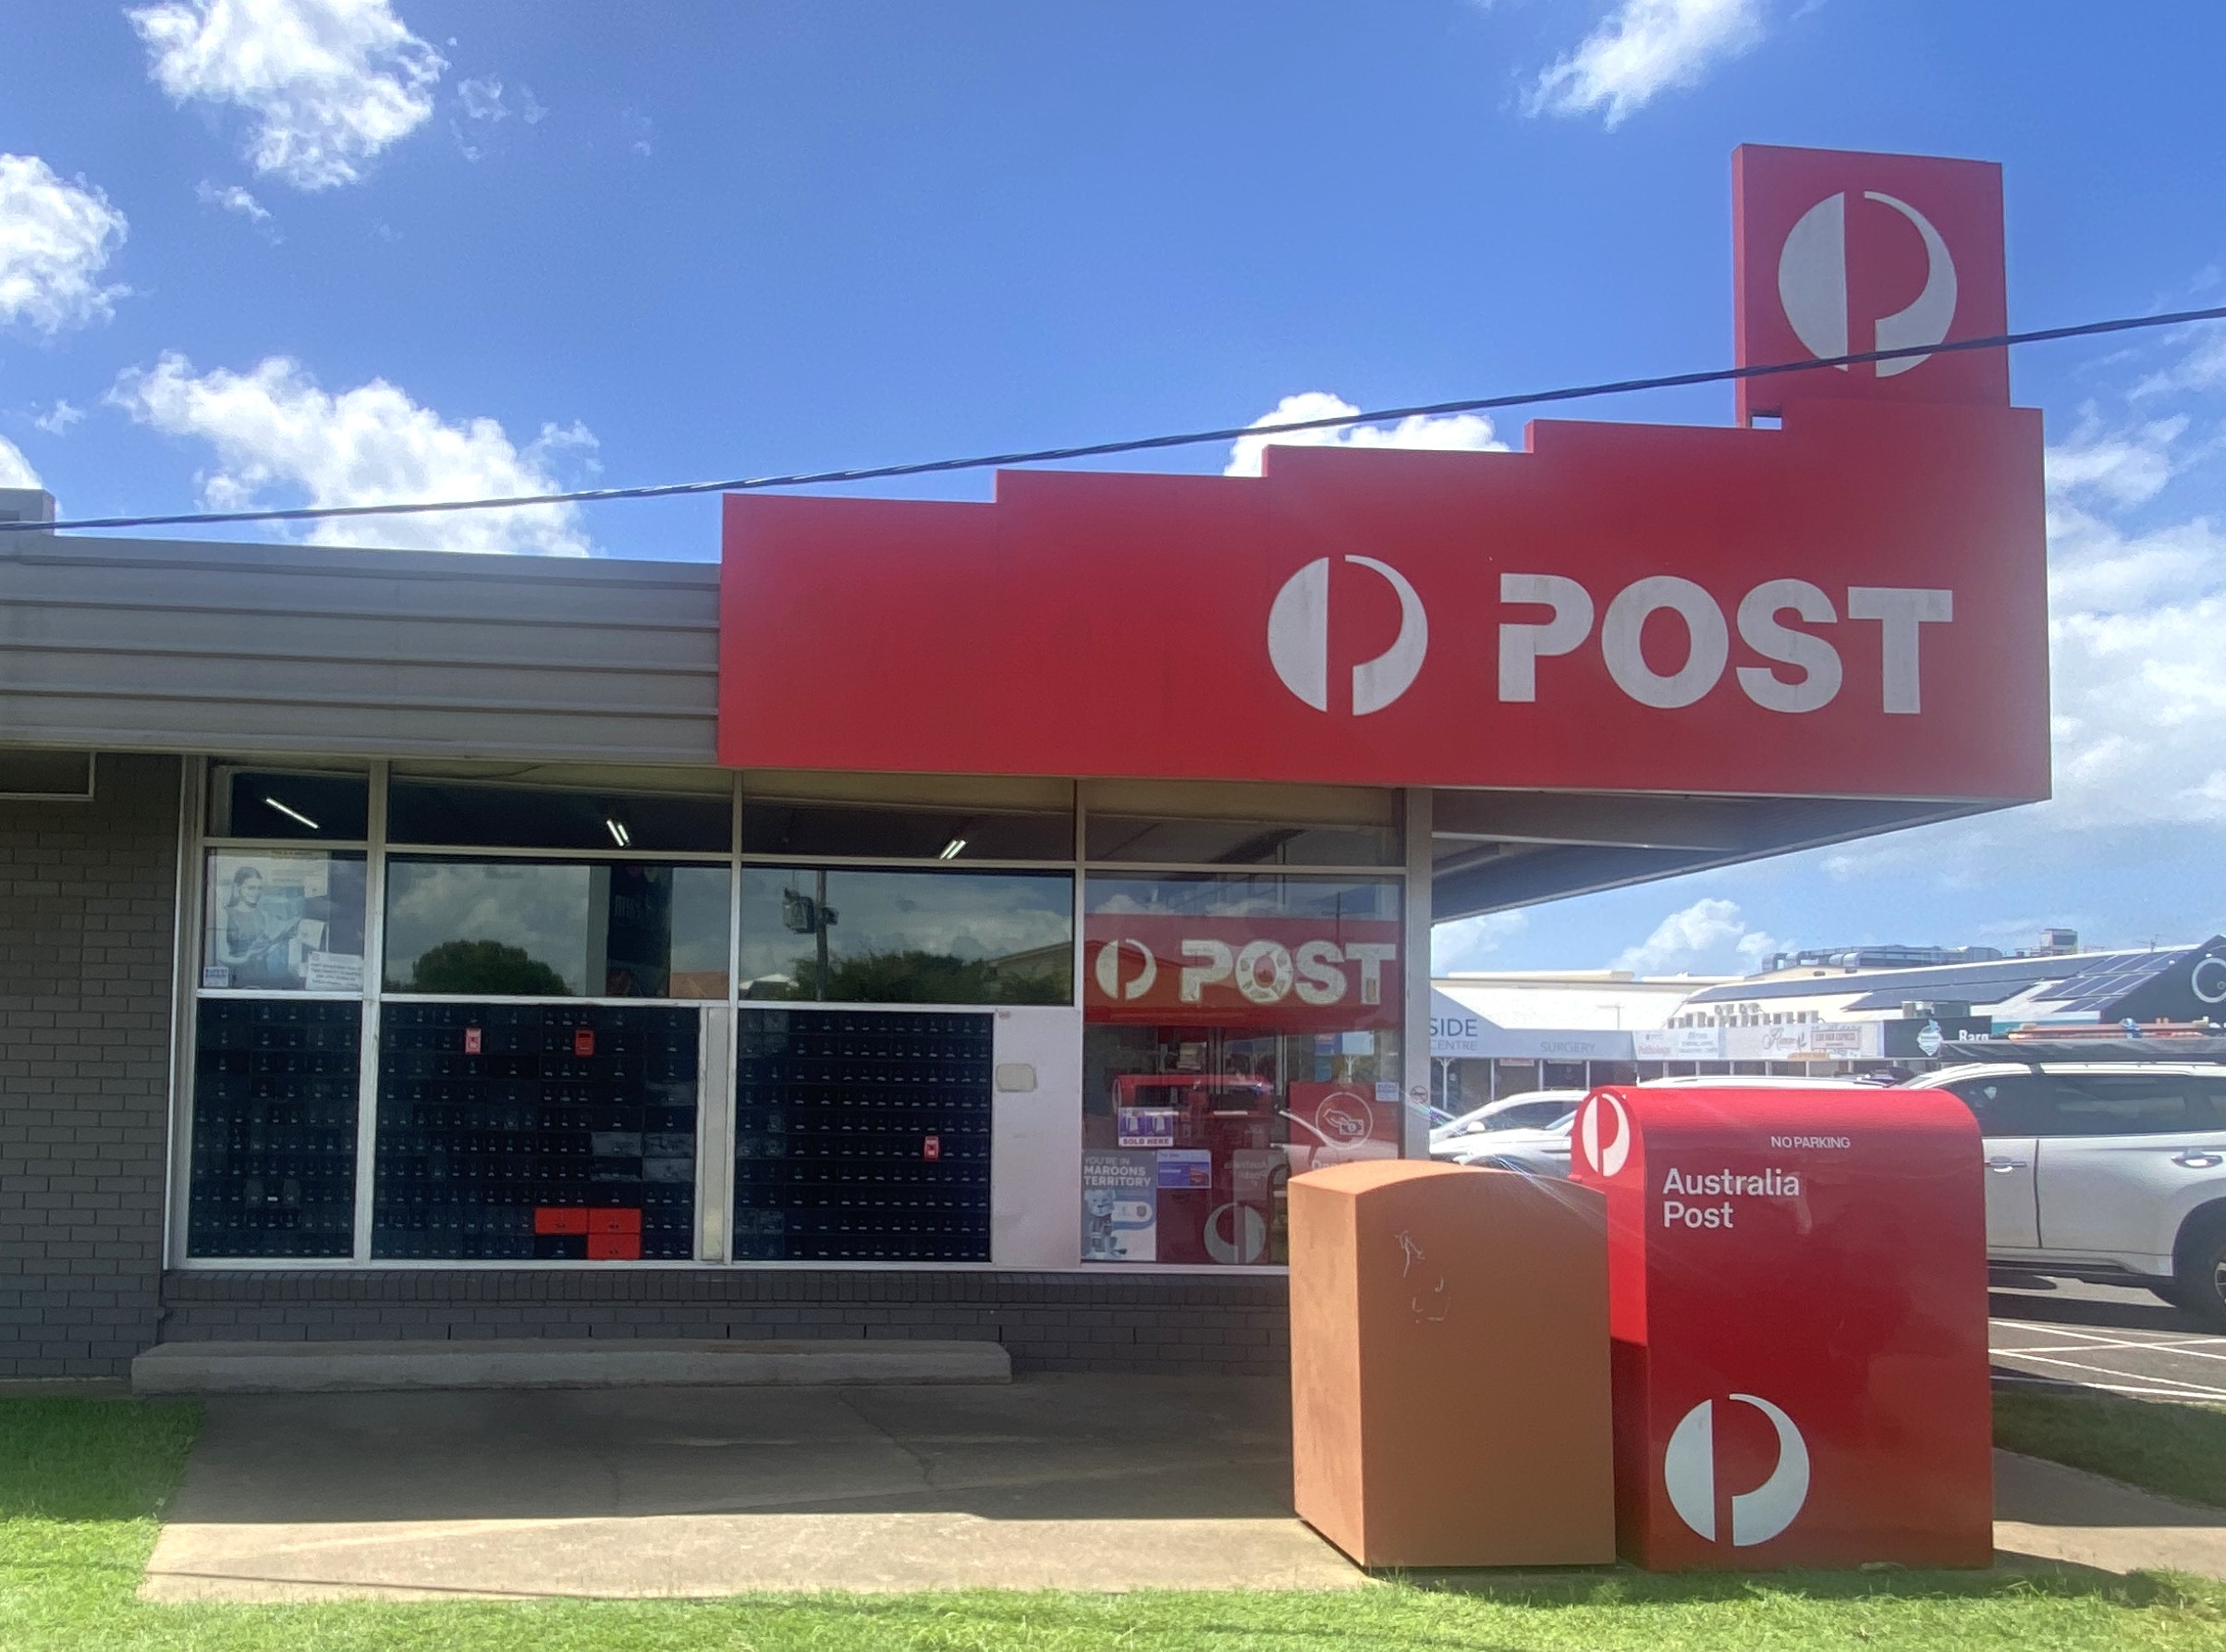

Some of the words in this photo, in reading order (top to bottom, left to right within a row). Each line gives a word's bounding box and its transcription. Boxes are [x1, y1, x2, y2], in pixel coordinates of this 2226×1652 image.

[1498, 572, 1953, 714] POST
[1180, 939, 1397, 1006] POST
[1540, 1041, 1596, 1053] SURGERY
[1770, 1136, 1792, 1148] NO
[1793, 1136, 1852, 1149] PARKING
[1083, 1166, 1146, 1177] MAROONS
[1083, 1175, 1152, 1187] TERRITORY
[1662, 1168, 1801, 1196] Australia
[1664, 1200, 1734, 1229] Post
